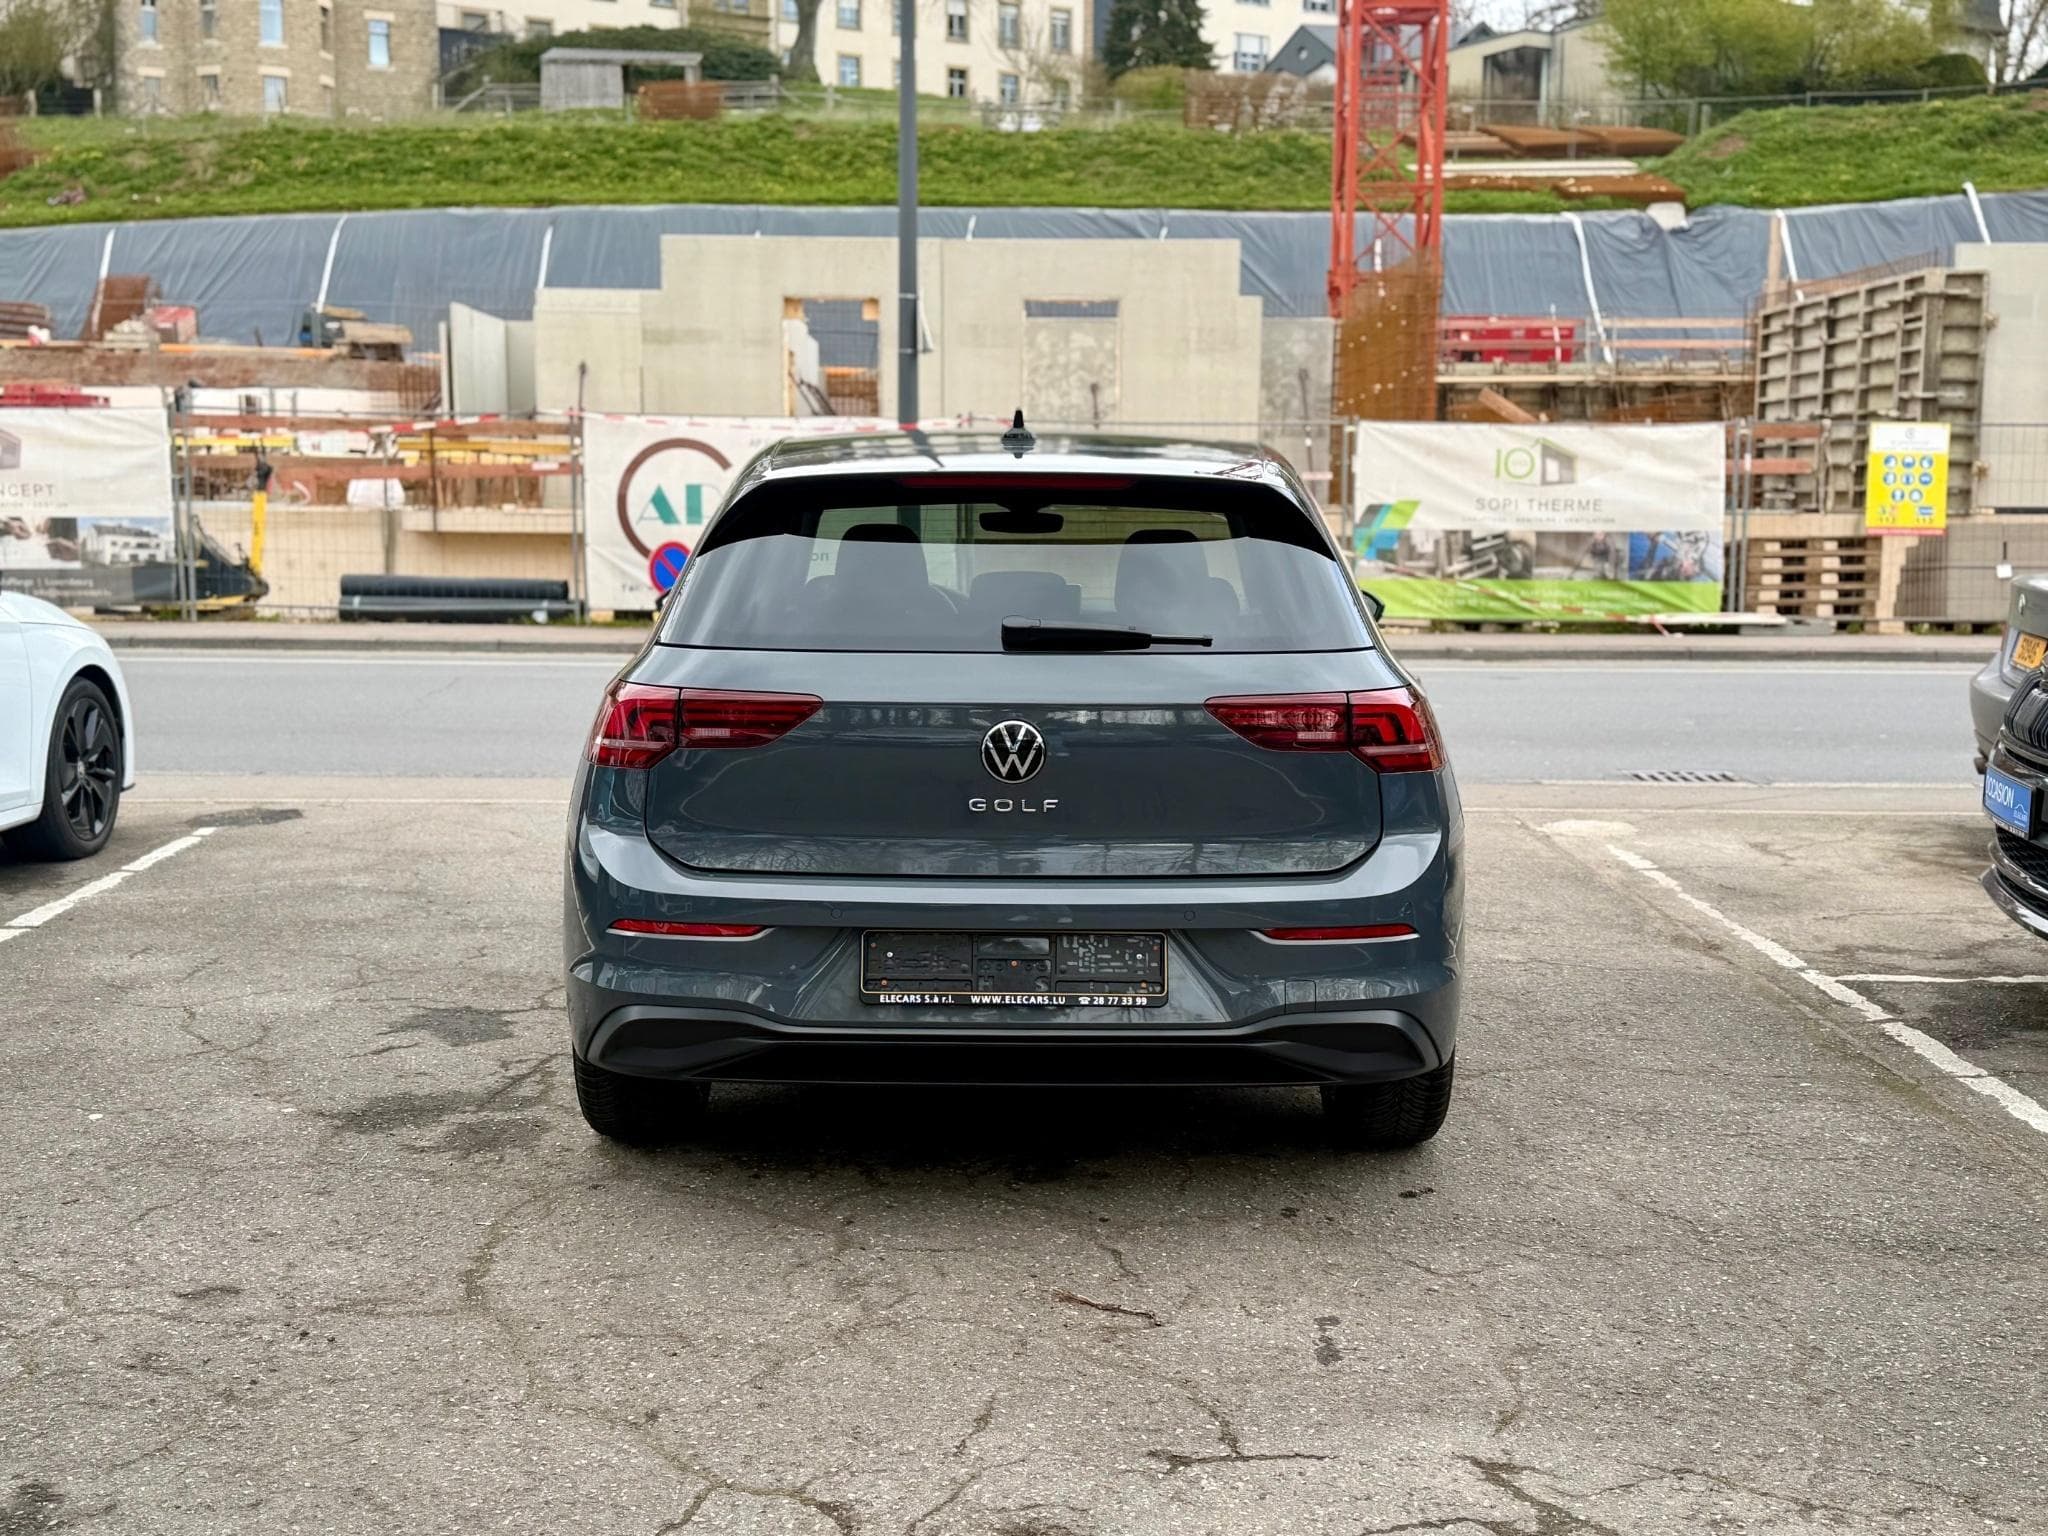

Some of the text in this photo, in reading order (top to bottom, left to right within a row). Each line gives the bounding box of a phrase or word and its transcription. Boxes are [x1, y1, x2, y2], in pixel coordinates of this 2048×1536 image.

[1475, 498, 1603, 512] SOPI THERME
[984, 721, 1043, 781] VW
[969, 799, 1059, 812] GOLF
[879, 994, 921, 1003] ELECARS
[970, 995, 1066, 1005] WWW.ELECARS.LU
[1107, 996, 1119, 1005] 77
[1121, 996, 1133, 1005] 33
[1135, 996, 1148, 1006] 99
